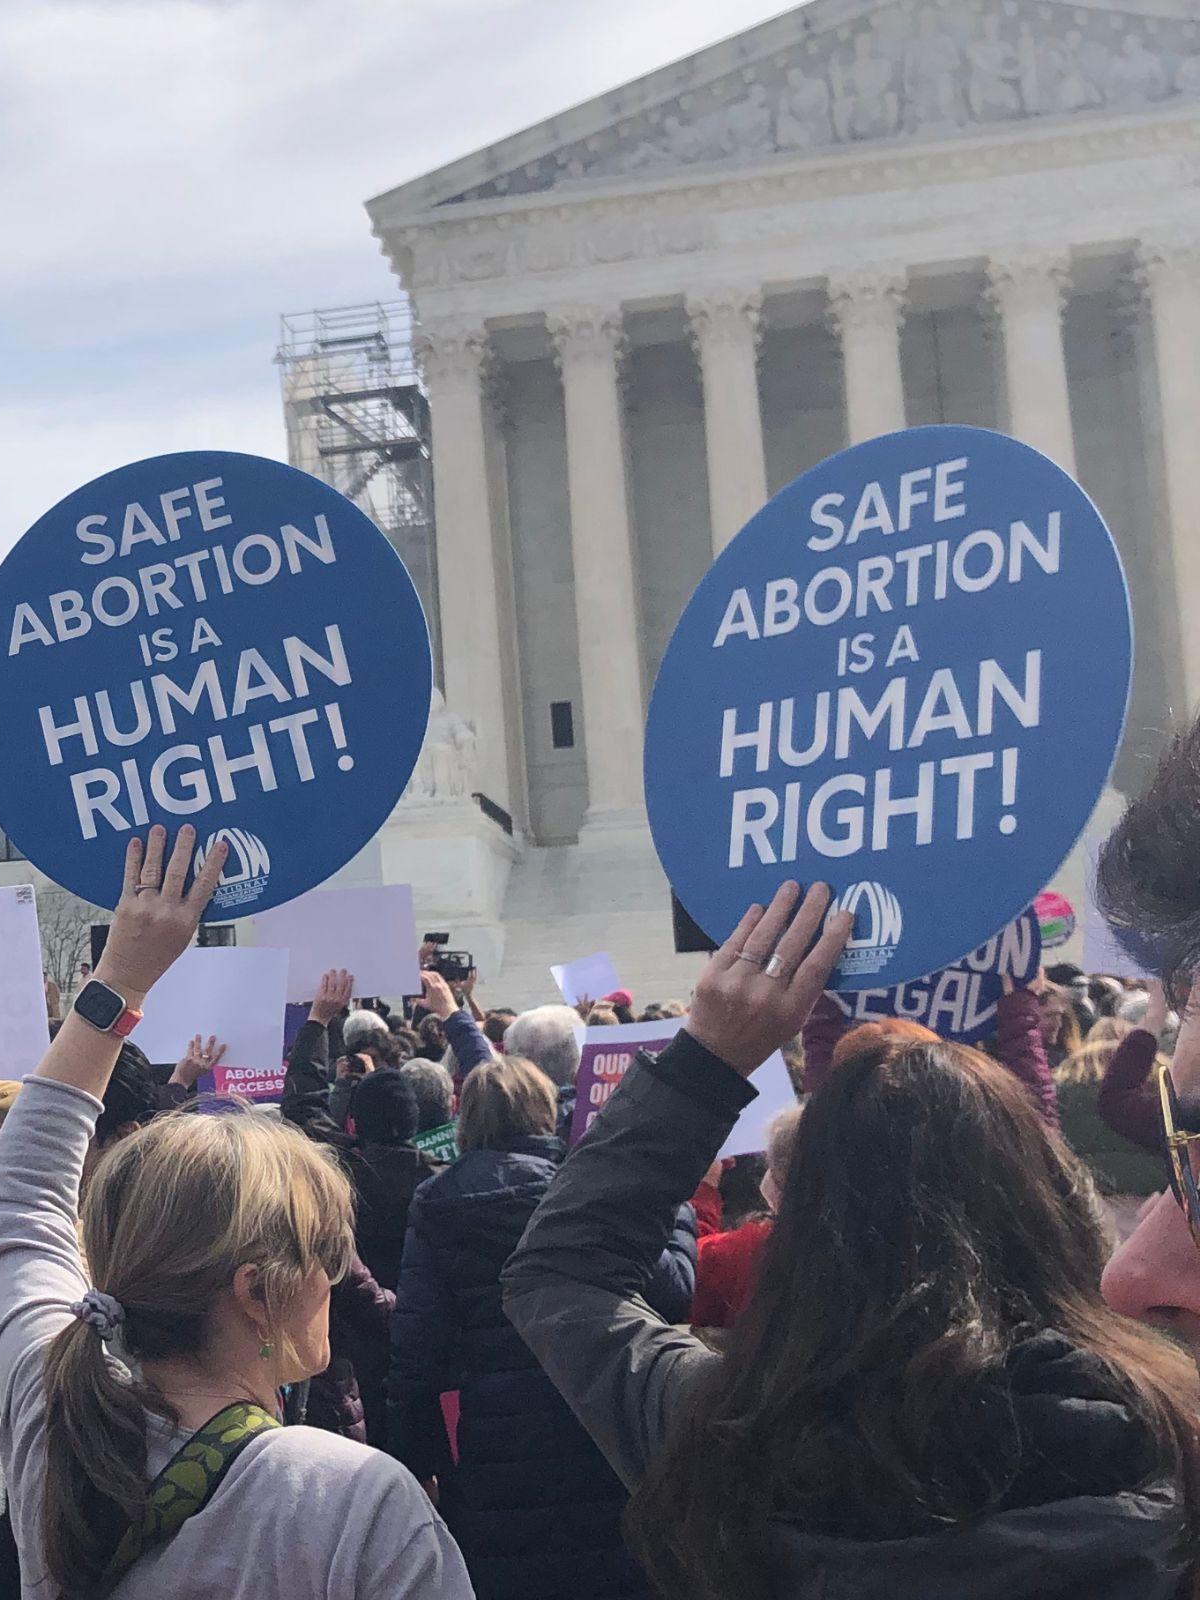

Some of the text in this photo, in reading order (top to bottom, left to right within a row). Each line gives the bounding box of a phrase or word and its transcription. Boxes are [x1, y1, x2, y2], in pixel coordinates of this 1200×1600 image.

[75, 476, 233, 565] SAFE
[806, 457, 969, 552] SAFE
[8, 513, 337, 657] ABORTION
[712, 511, 1062, 648] ABORTION
[138, 617, 223, 667] IS A
[836, 624, 920, 676] IS A
[38, 624, 353, 766] HUMAN
[719, 649, 1042, 778] HUMAN
[69, 702, 355, 840] RIGHT!
[728, 747, 1019, 868] RIGHT!
[214, 877, 268, 896] ATIONAL
[225, 1065, 288, 1080] ABORTIO
[227, 1079, 285, 1093] ACCESS
[593, 1053, 632, 1075] OUR
